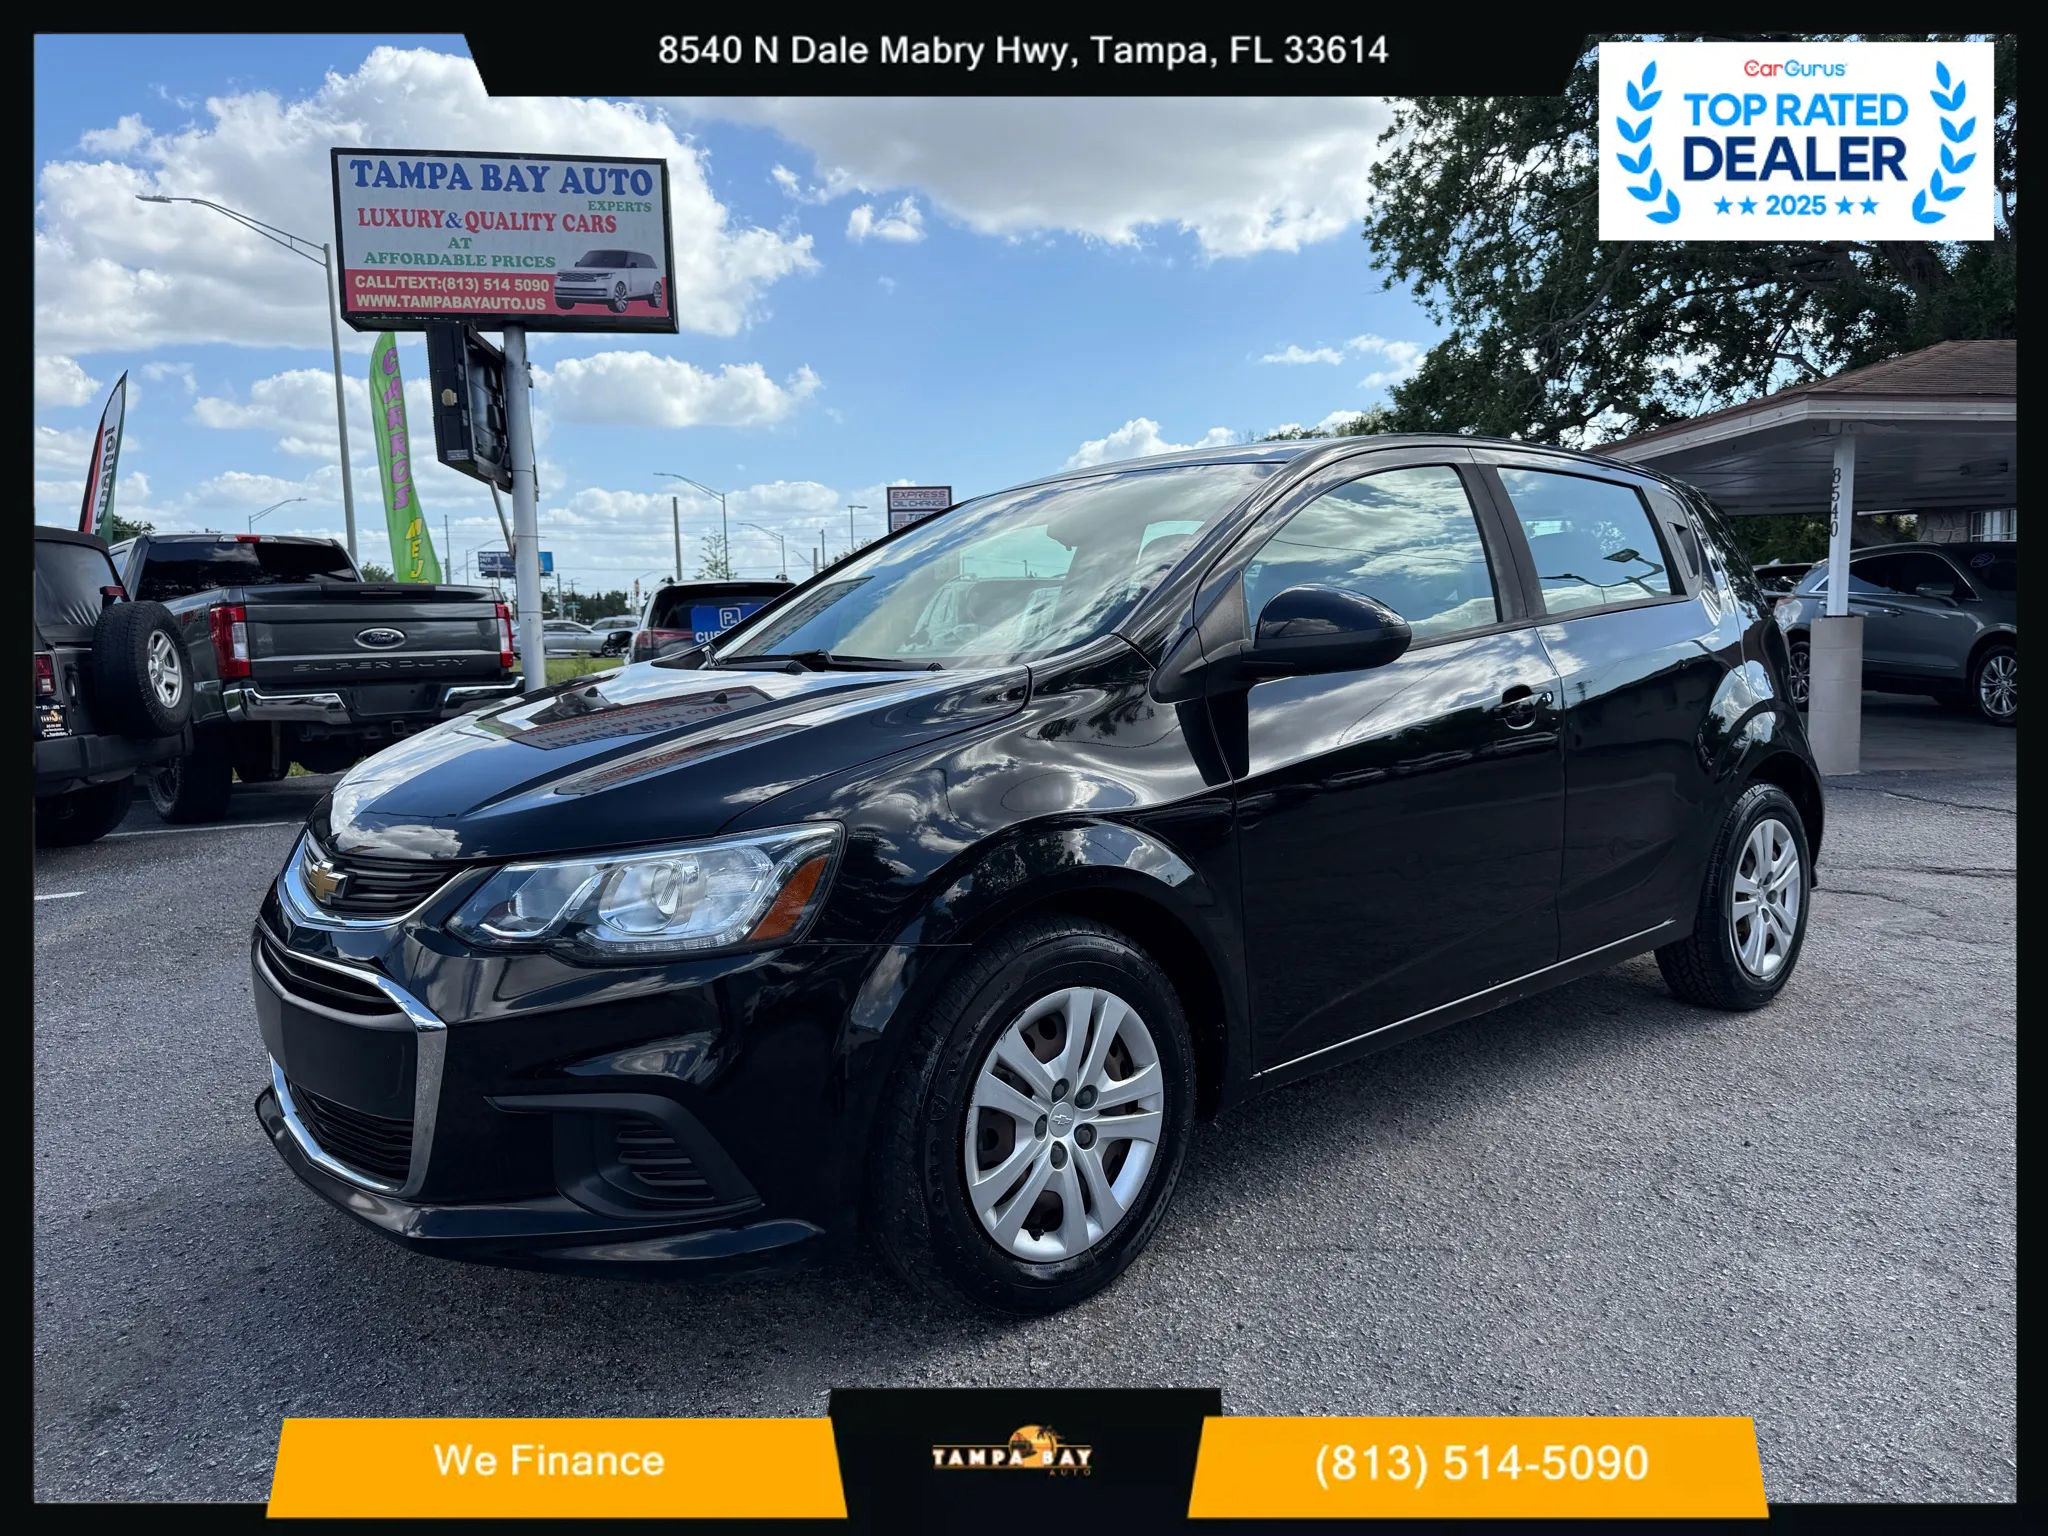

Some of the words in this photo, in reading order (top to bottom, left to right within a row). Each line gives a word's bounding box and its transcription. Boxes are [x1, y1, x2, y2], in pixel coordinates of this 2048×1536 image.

[350, 159, 473, 191] TAMPA
[480, 164, 551, 193] BAY
[559, 166, 653, 197] AUTO
[588, 200, 652, 213] EXPERTS
[562, 213, 617, 233] CARS
[448, 236, 472, 249] AT
[364, 251, 487, 266] AFFORDABLE
[491, 255, 556, 268] PRICES
[484, 278, 510, 291] 514
[514, 279, 549, 292] 5090
[356, 294, 547, 311] WWW.TAMPABAYAUTO.US
[892, 490, 947, 499] EXPRESS
[1830, 467, 1842, 538] 8540
[368, 631, 394, 643] Ford
[293, 661, 391, 672] SUPER
[400, 659, 468, 668] DUTY
